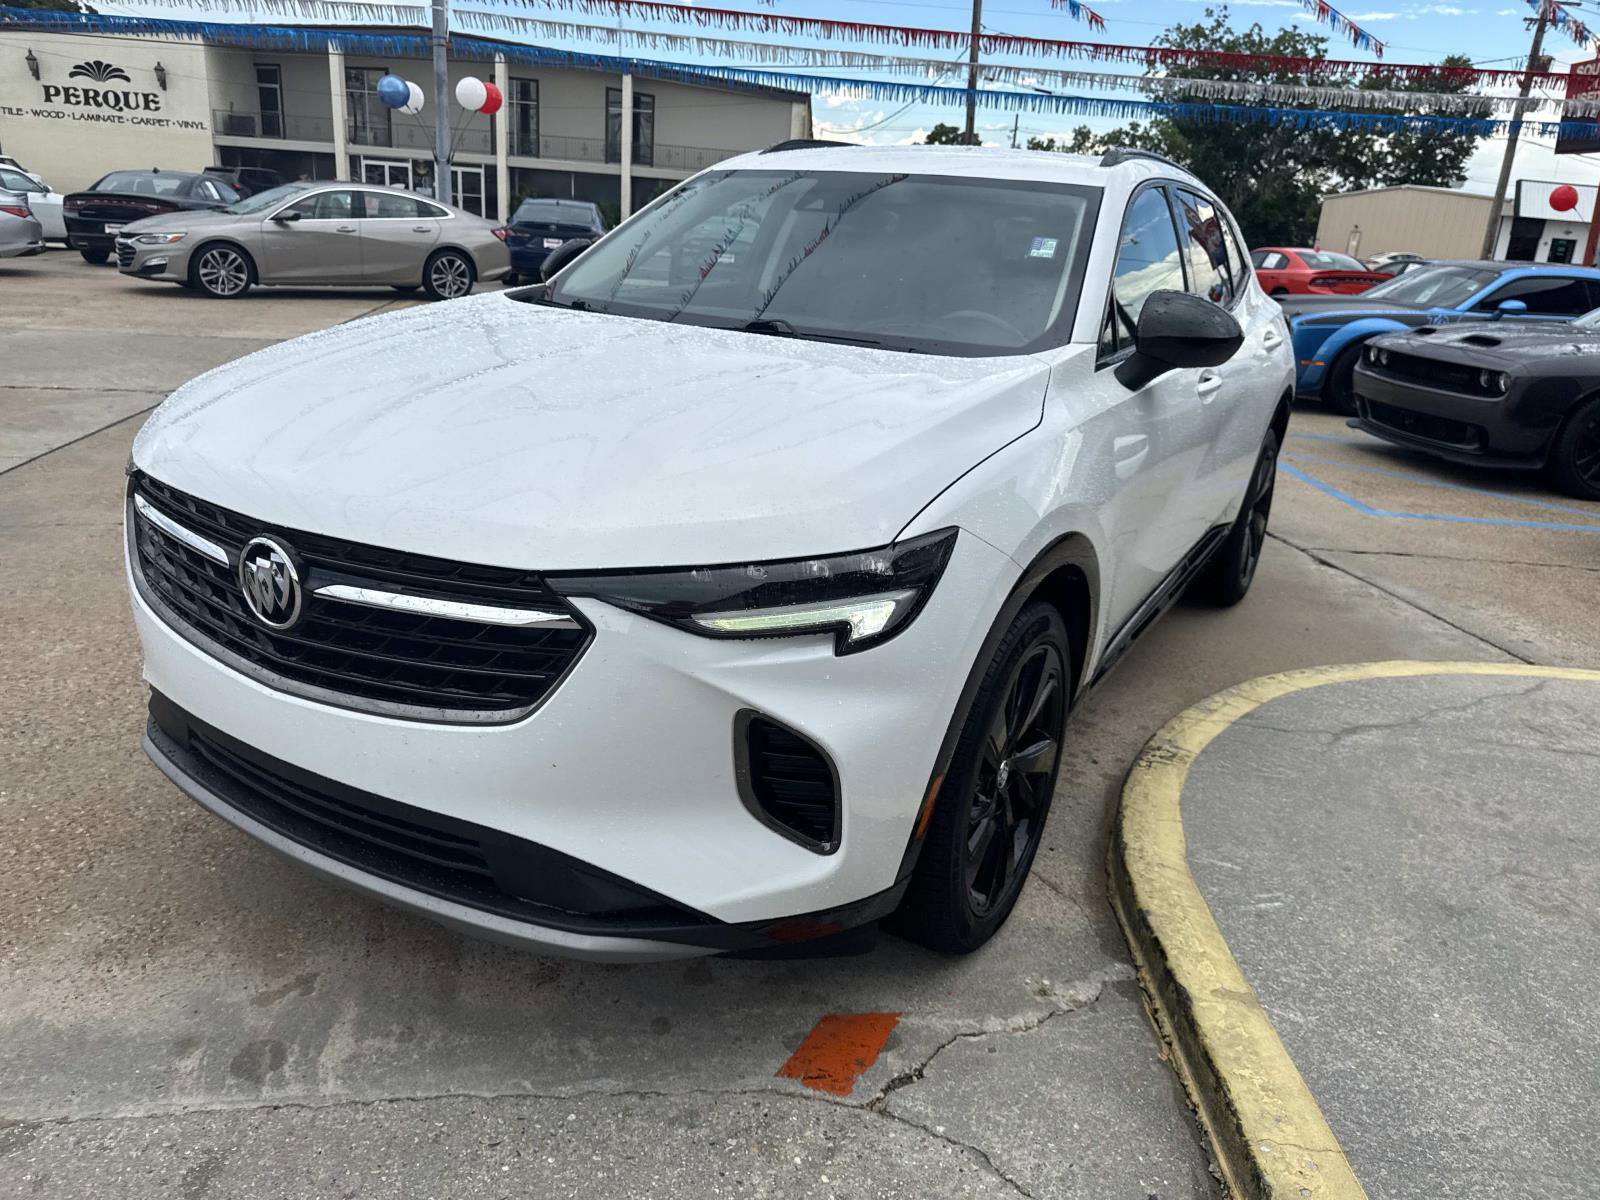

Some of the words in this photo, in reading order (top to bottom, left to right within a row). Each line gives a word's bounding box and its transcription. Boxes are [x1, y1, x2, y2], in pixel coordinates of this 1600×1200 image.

[42, 85, 161, 112] PERQUE
[0, 106, 24, 116] TILE
[31, 108, 65, 119] WOOD
[72, 112, 124, 124] LAMINATE
[131, 117, 171, 127] CARPET
[177, 120, 207, 130] VINYL
